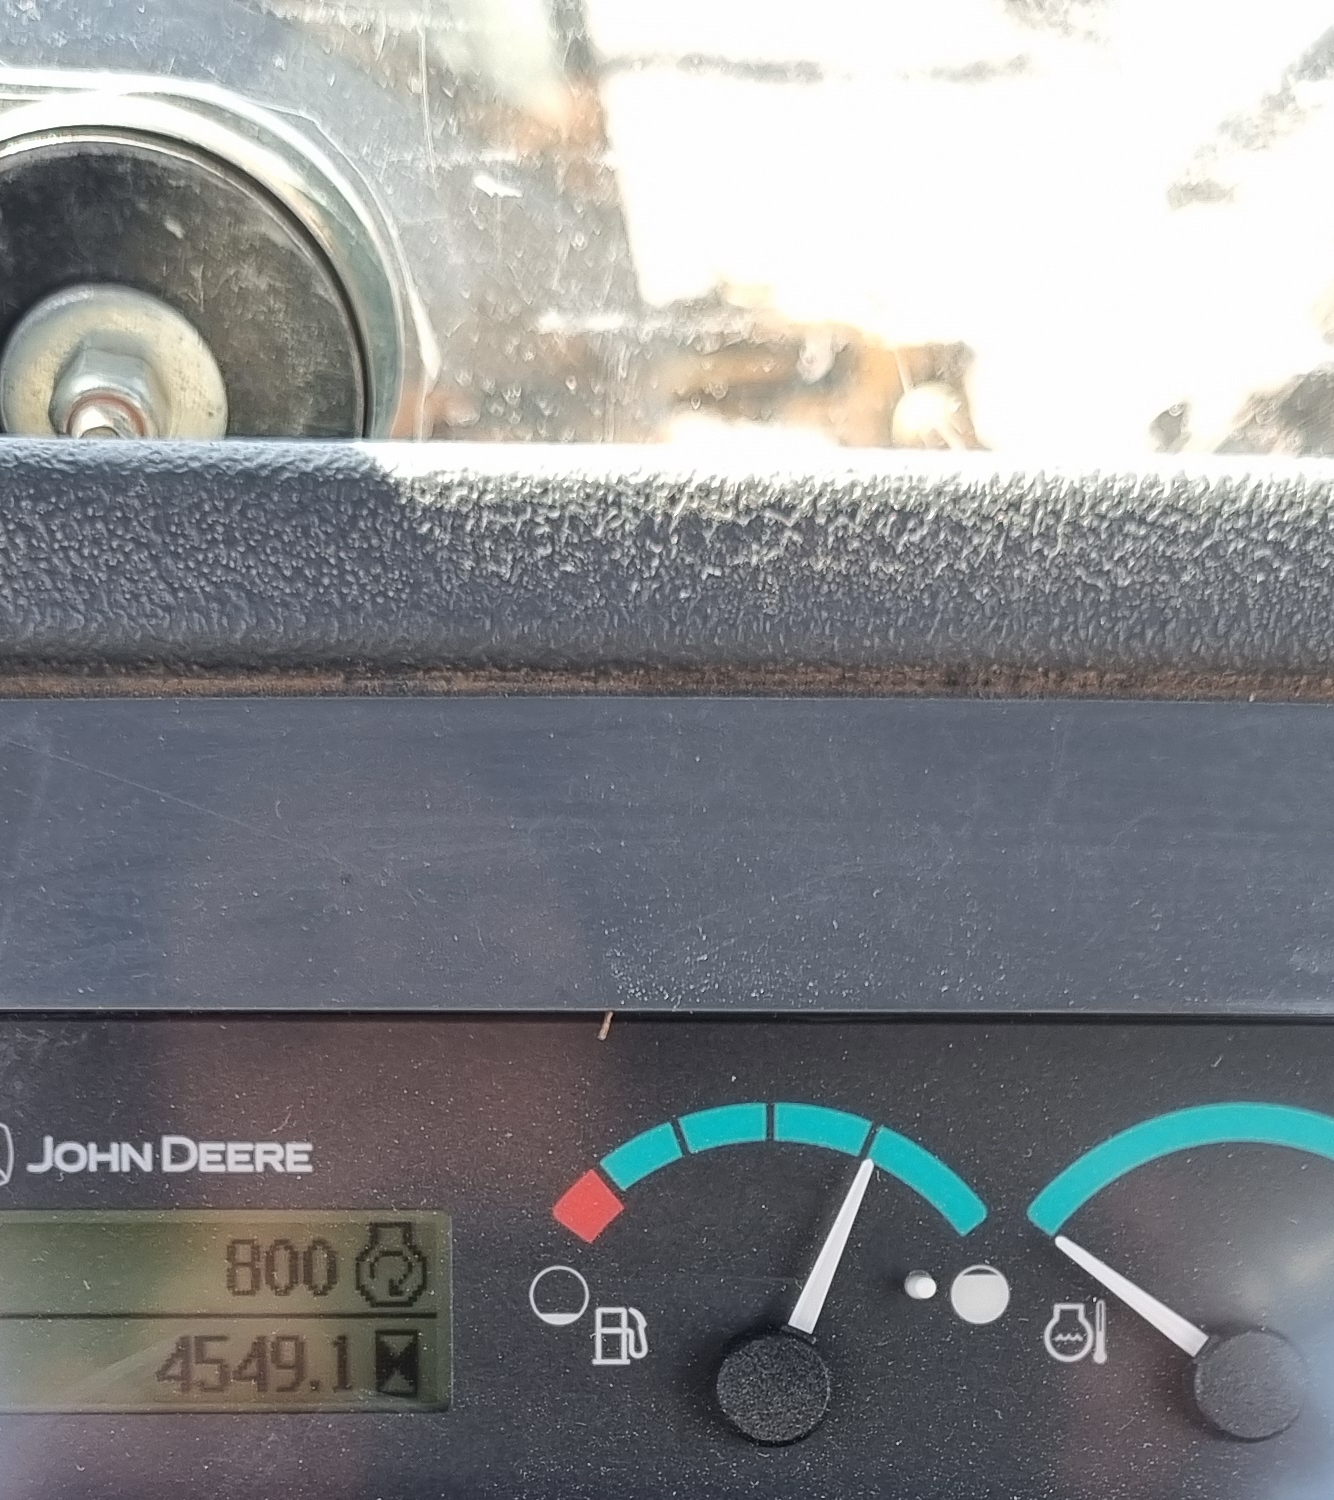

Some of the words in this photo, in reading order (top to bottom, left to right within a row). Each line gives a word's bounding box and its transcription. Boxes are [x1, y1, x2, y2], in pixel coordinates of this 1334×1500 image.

[26, 1135, 153, 1173] JOHN
[161, 1135, 313, 1173] DEERE
[225, 1237, 338, 1297] 800
[155, 1334, 354, 1393] 4549.1
